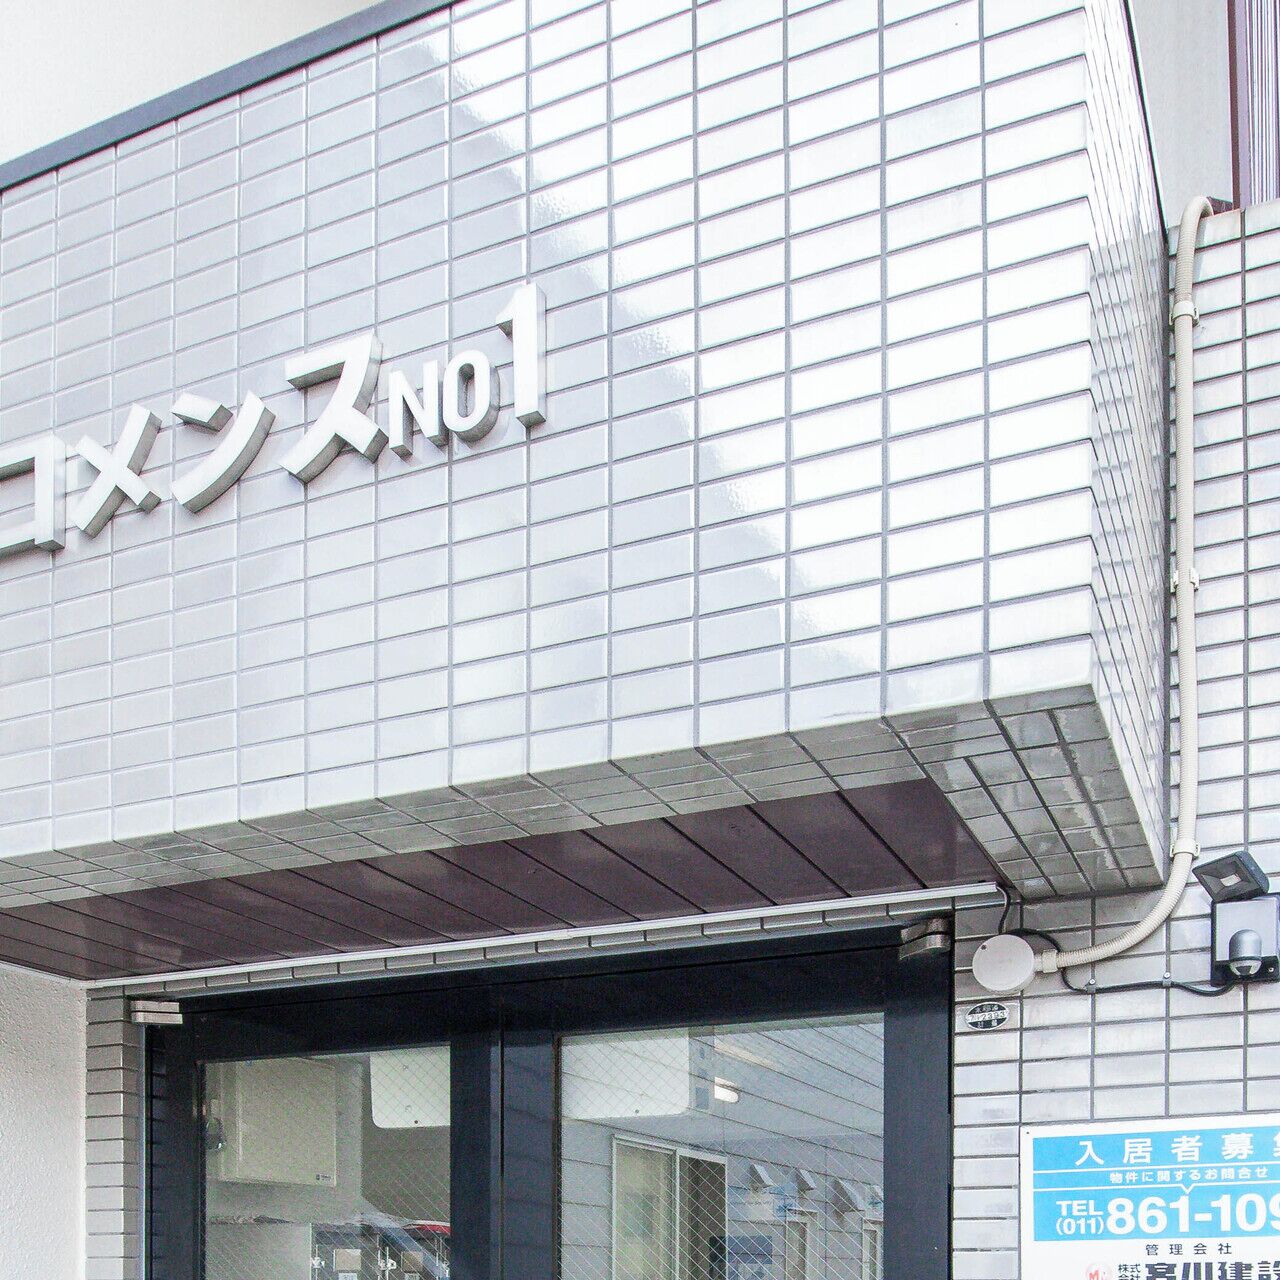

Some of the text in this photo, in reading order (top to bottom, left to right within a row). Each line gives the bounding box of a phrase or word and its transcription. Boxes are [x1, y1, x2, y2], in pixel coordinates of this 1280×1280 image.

[1109, 1166, 1269, 1184] 物件に関するお問合せ
[1056, 1200, 1104, 1216] TEL
[1055, 1216, 1105, 1235] (011)
[1145, 1243, 1233, 1256] 管理会社
